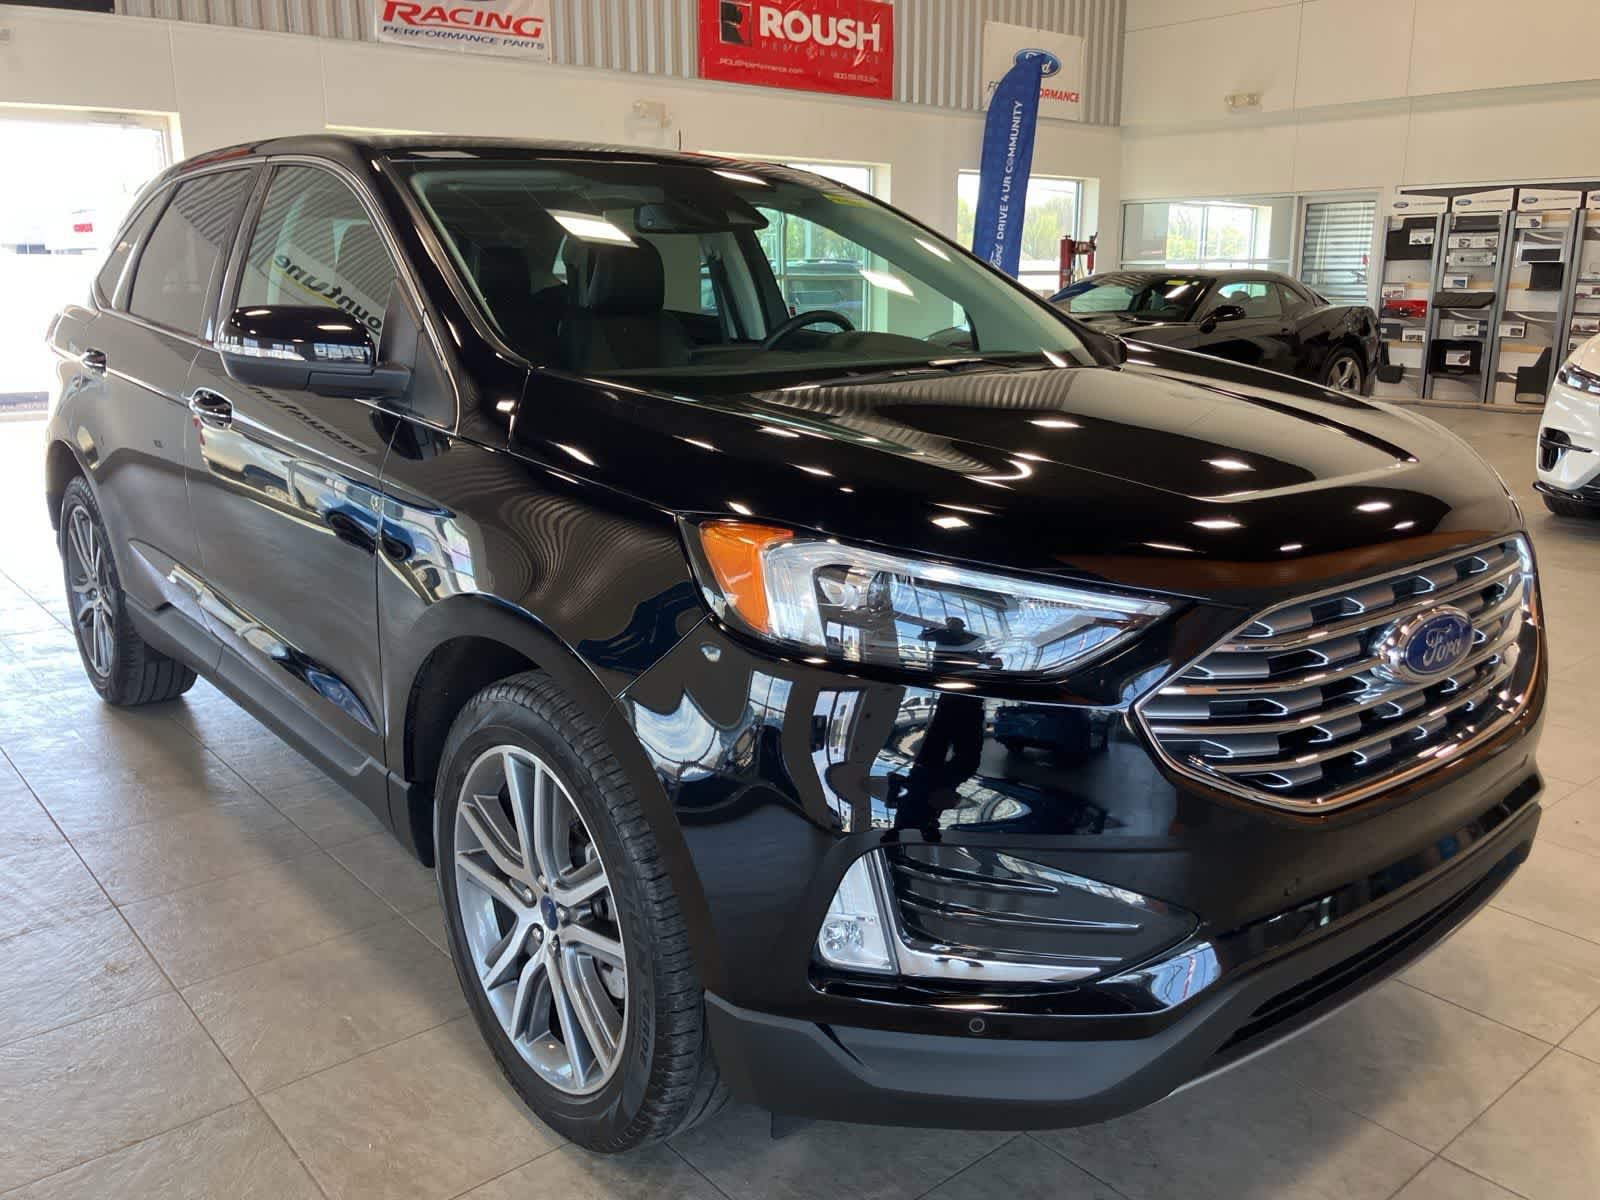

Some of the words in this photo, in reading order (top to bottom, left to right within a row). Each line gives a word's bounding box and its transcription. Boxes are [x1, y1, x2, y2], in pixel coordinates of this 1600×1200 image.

[382, 0, 544, 39] RACING
[383, 25, 499, 46] PERFORMANCE
[502, 39, 545, 50] PARTS
[759, 5, 881, 53] ROUSH
[1040, 87, 1080, 103] ORMANCE
[1006, 101, 1023, 174] COMMUNITY
[1003, 176, 1013, 193] UR
[996, 202, 1009, 239] DRIVE
[1423, 623, 1461, 667] Ford
